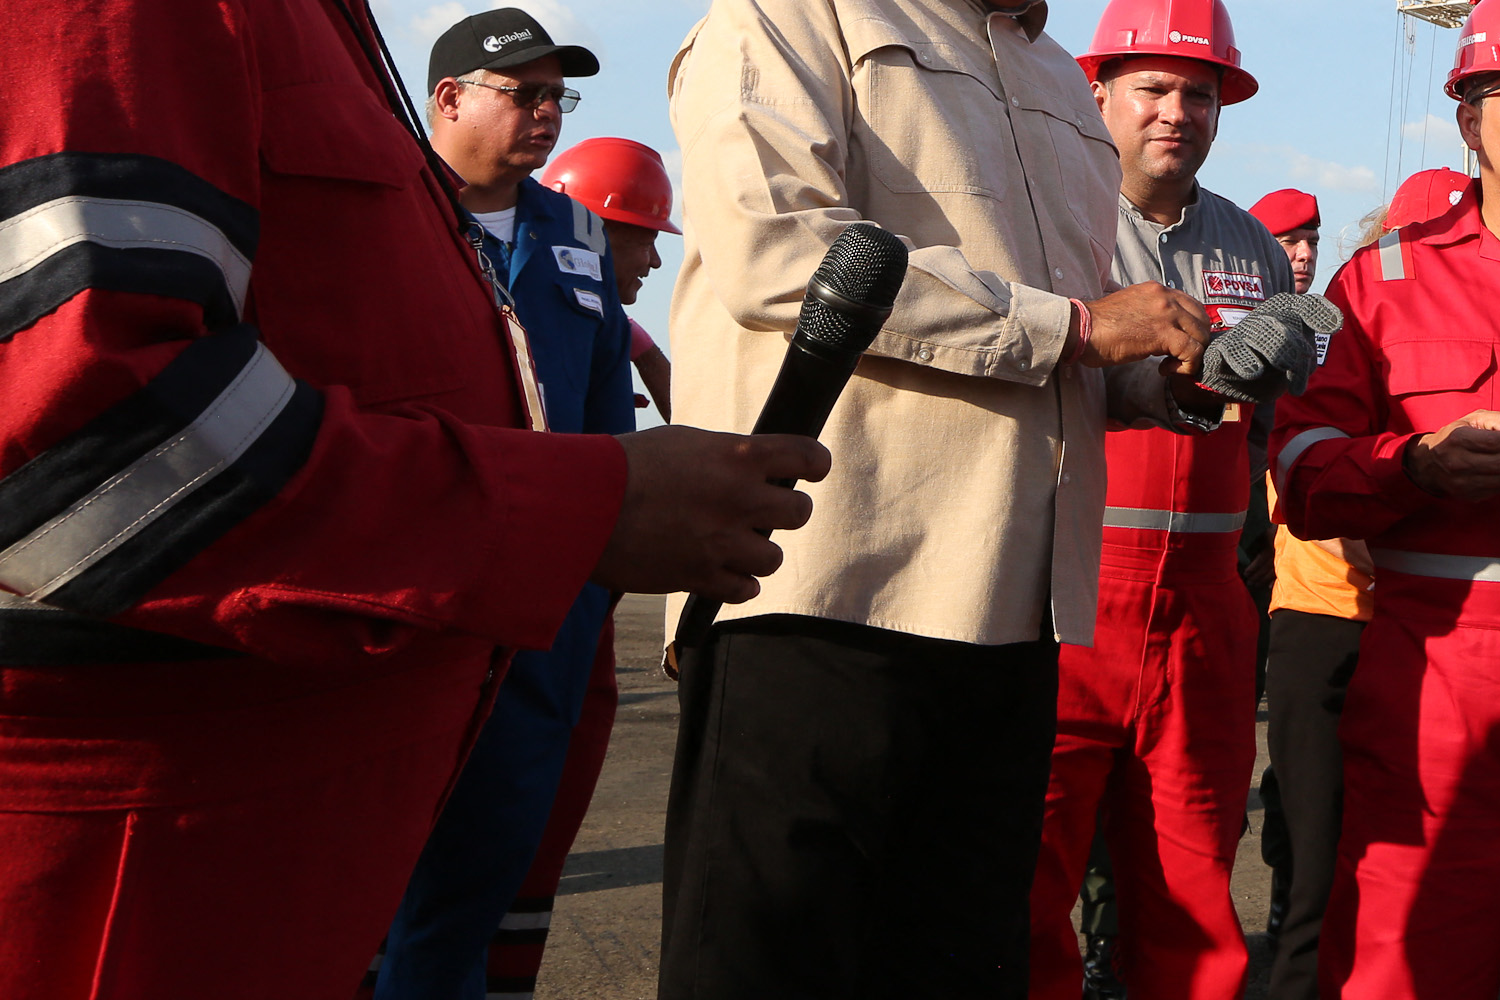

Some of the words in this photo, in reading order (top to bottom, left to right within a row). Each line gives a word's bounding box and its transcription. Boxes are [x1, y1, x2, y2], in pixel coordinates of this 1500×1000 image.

[498, 28, 532, 45] Global
[1182, 34, 1210, 45] PDVSA
[1225, 279, 1262, 293] PDVSA
